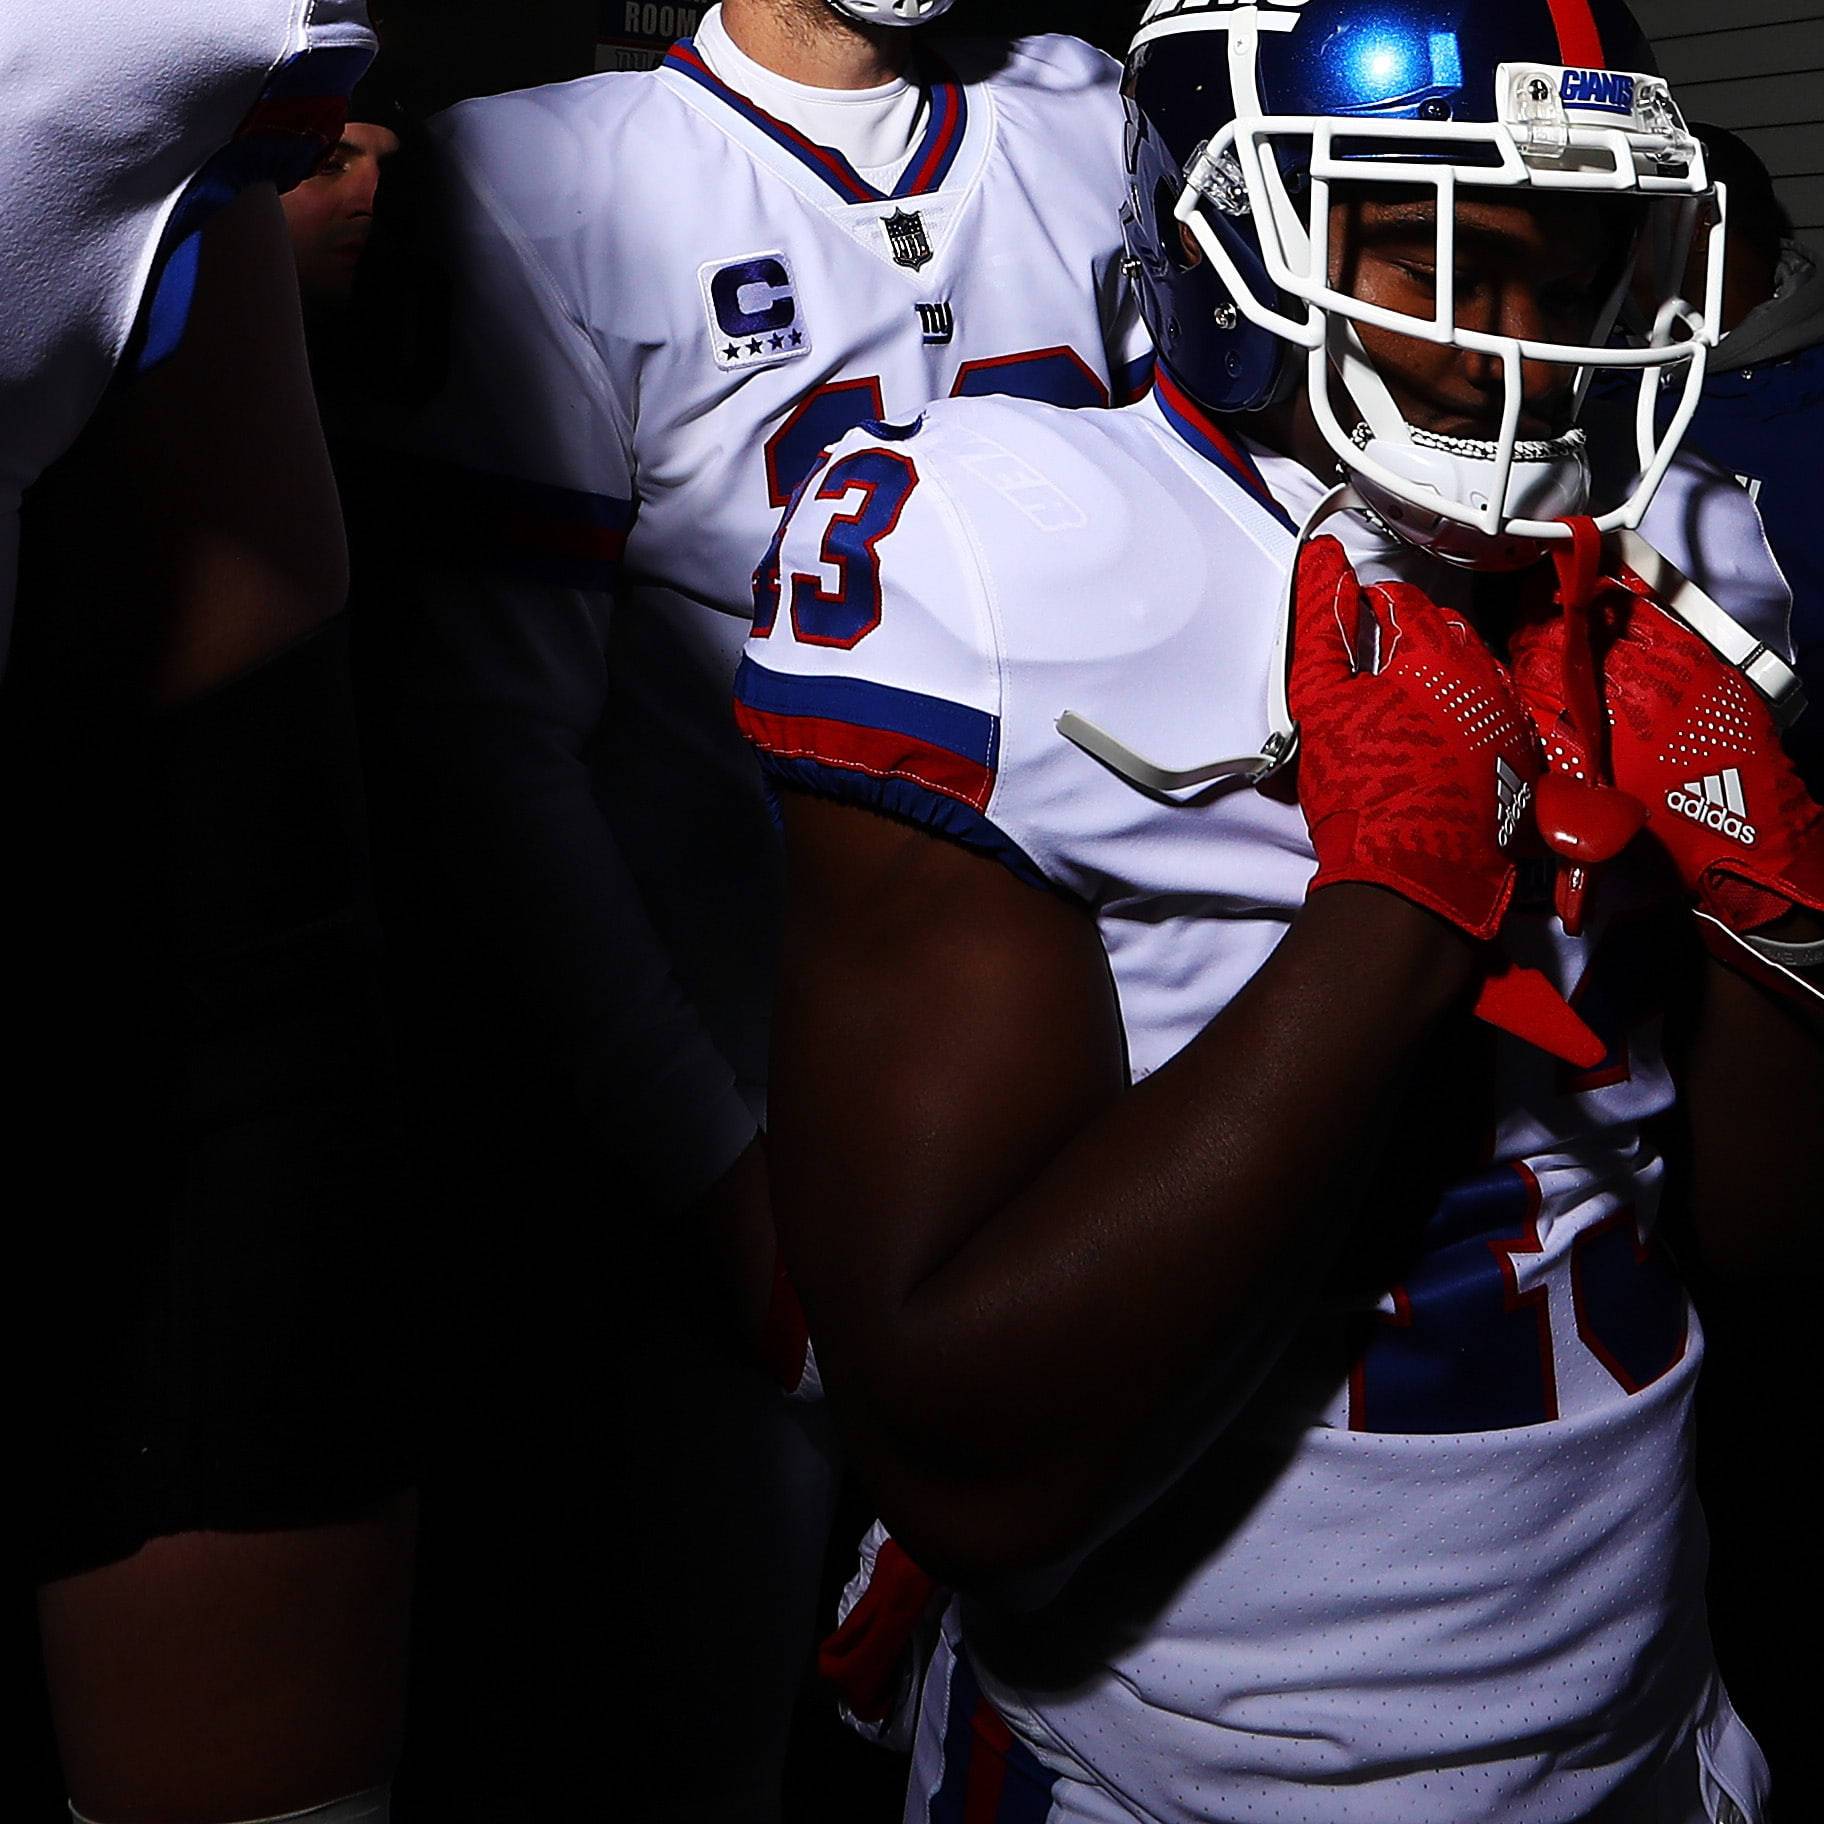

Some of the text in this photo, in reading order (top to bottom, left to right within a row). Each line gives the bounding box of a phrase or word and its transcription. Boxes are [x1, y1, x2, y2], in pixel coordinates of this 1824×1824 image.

[624, 0, 697, 39] ROOM
[1561, 70, 1633, 107] GIANTS
[710, 258, 795, 338] C
[1666, 789, 1756, 845] adidas
